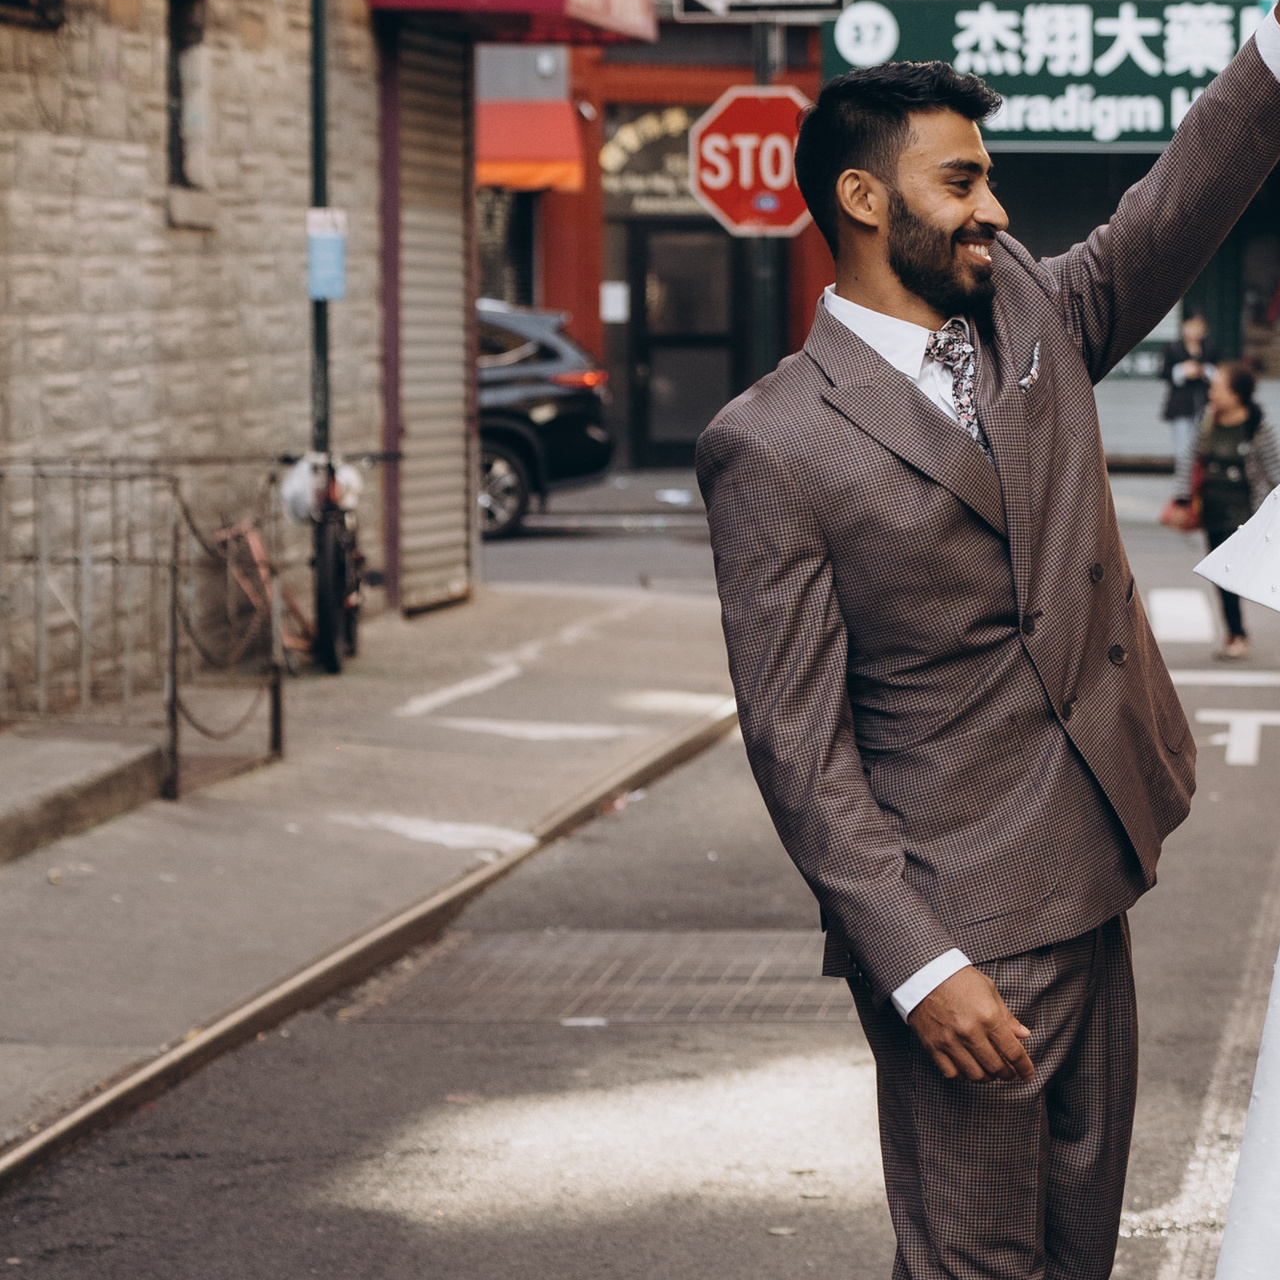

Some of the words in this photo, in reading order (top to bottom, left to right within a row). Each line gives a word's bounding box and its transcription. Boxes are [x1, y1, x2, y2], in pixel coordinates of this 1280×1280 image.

[952, 1, 1264, 78] 杰翔大藥
[983, 84, 1165, 142] aradigm
[700, 133, 796, 190] STO
